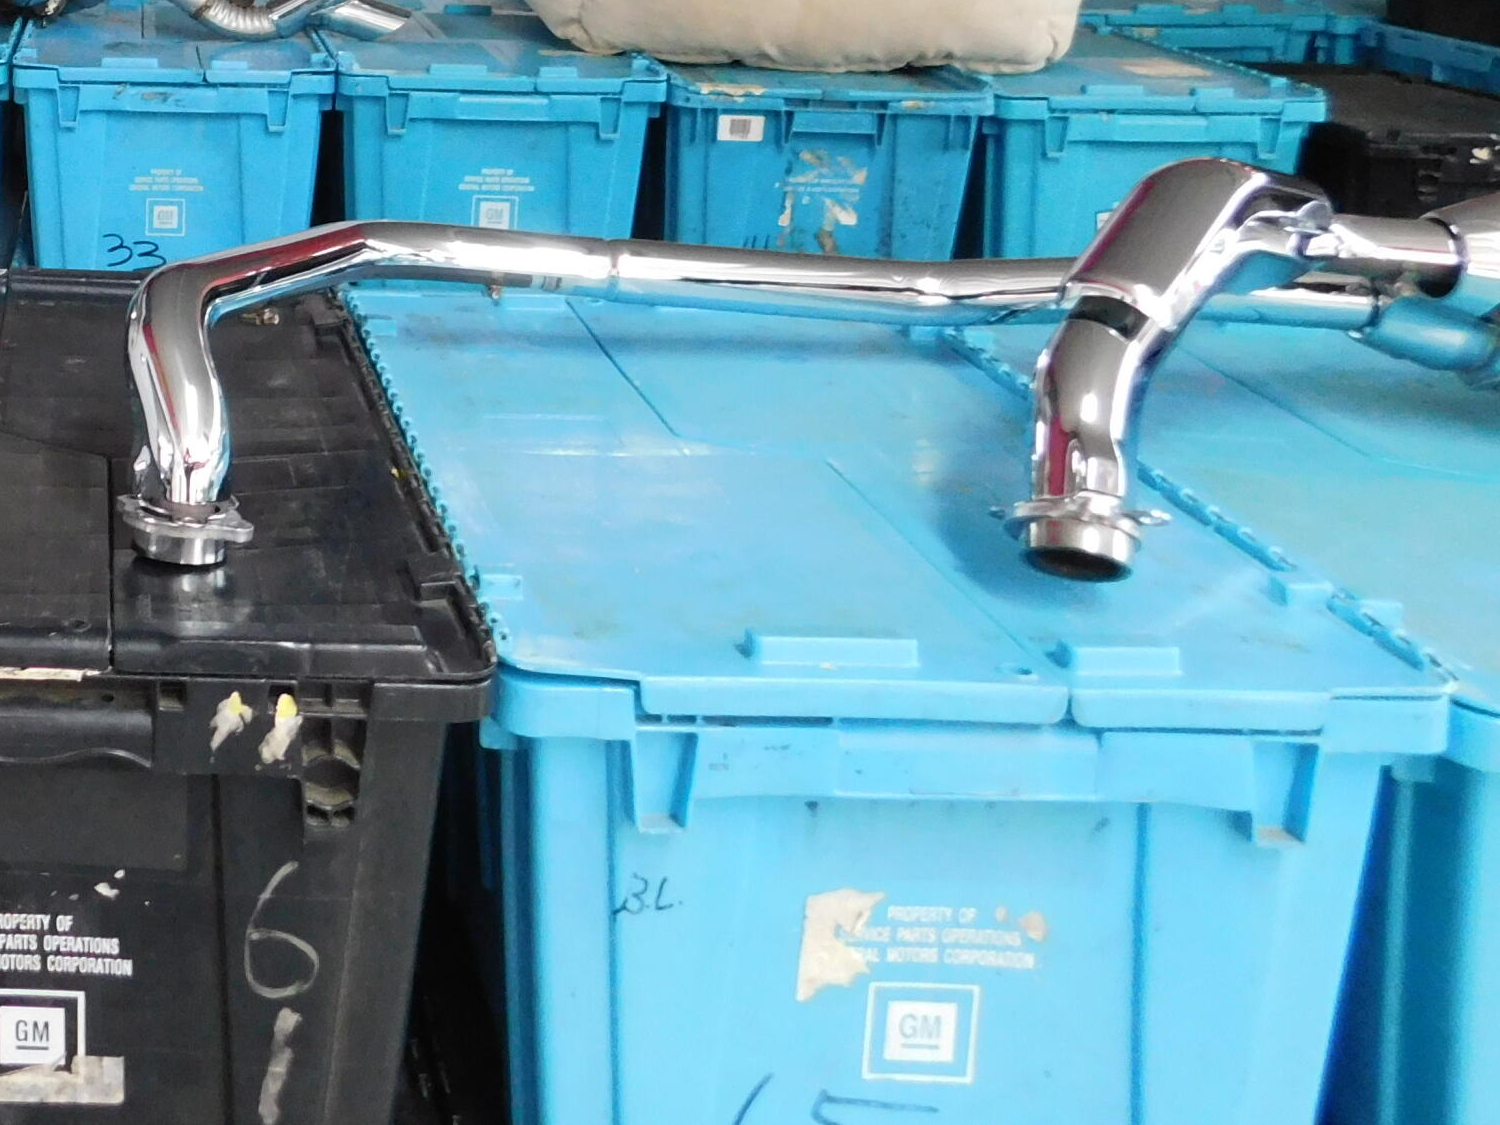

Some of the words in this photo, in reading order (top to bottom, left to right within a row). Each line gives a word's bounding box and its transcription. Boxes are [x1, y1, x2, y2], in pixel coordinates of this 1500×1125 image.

[103, 234, 168, 271] 33
[56, 915, 74, 931] OF
[958, 907, 977, 924] OF
[43, 935, 120, 955] OPERATIONS
[46, 955, 133, 977] CORPORATION
[14, 1020, 50, 1043] GM
[899, 1012, 943, 1040] GM
